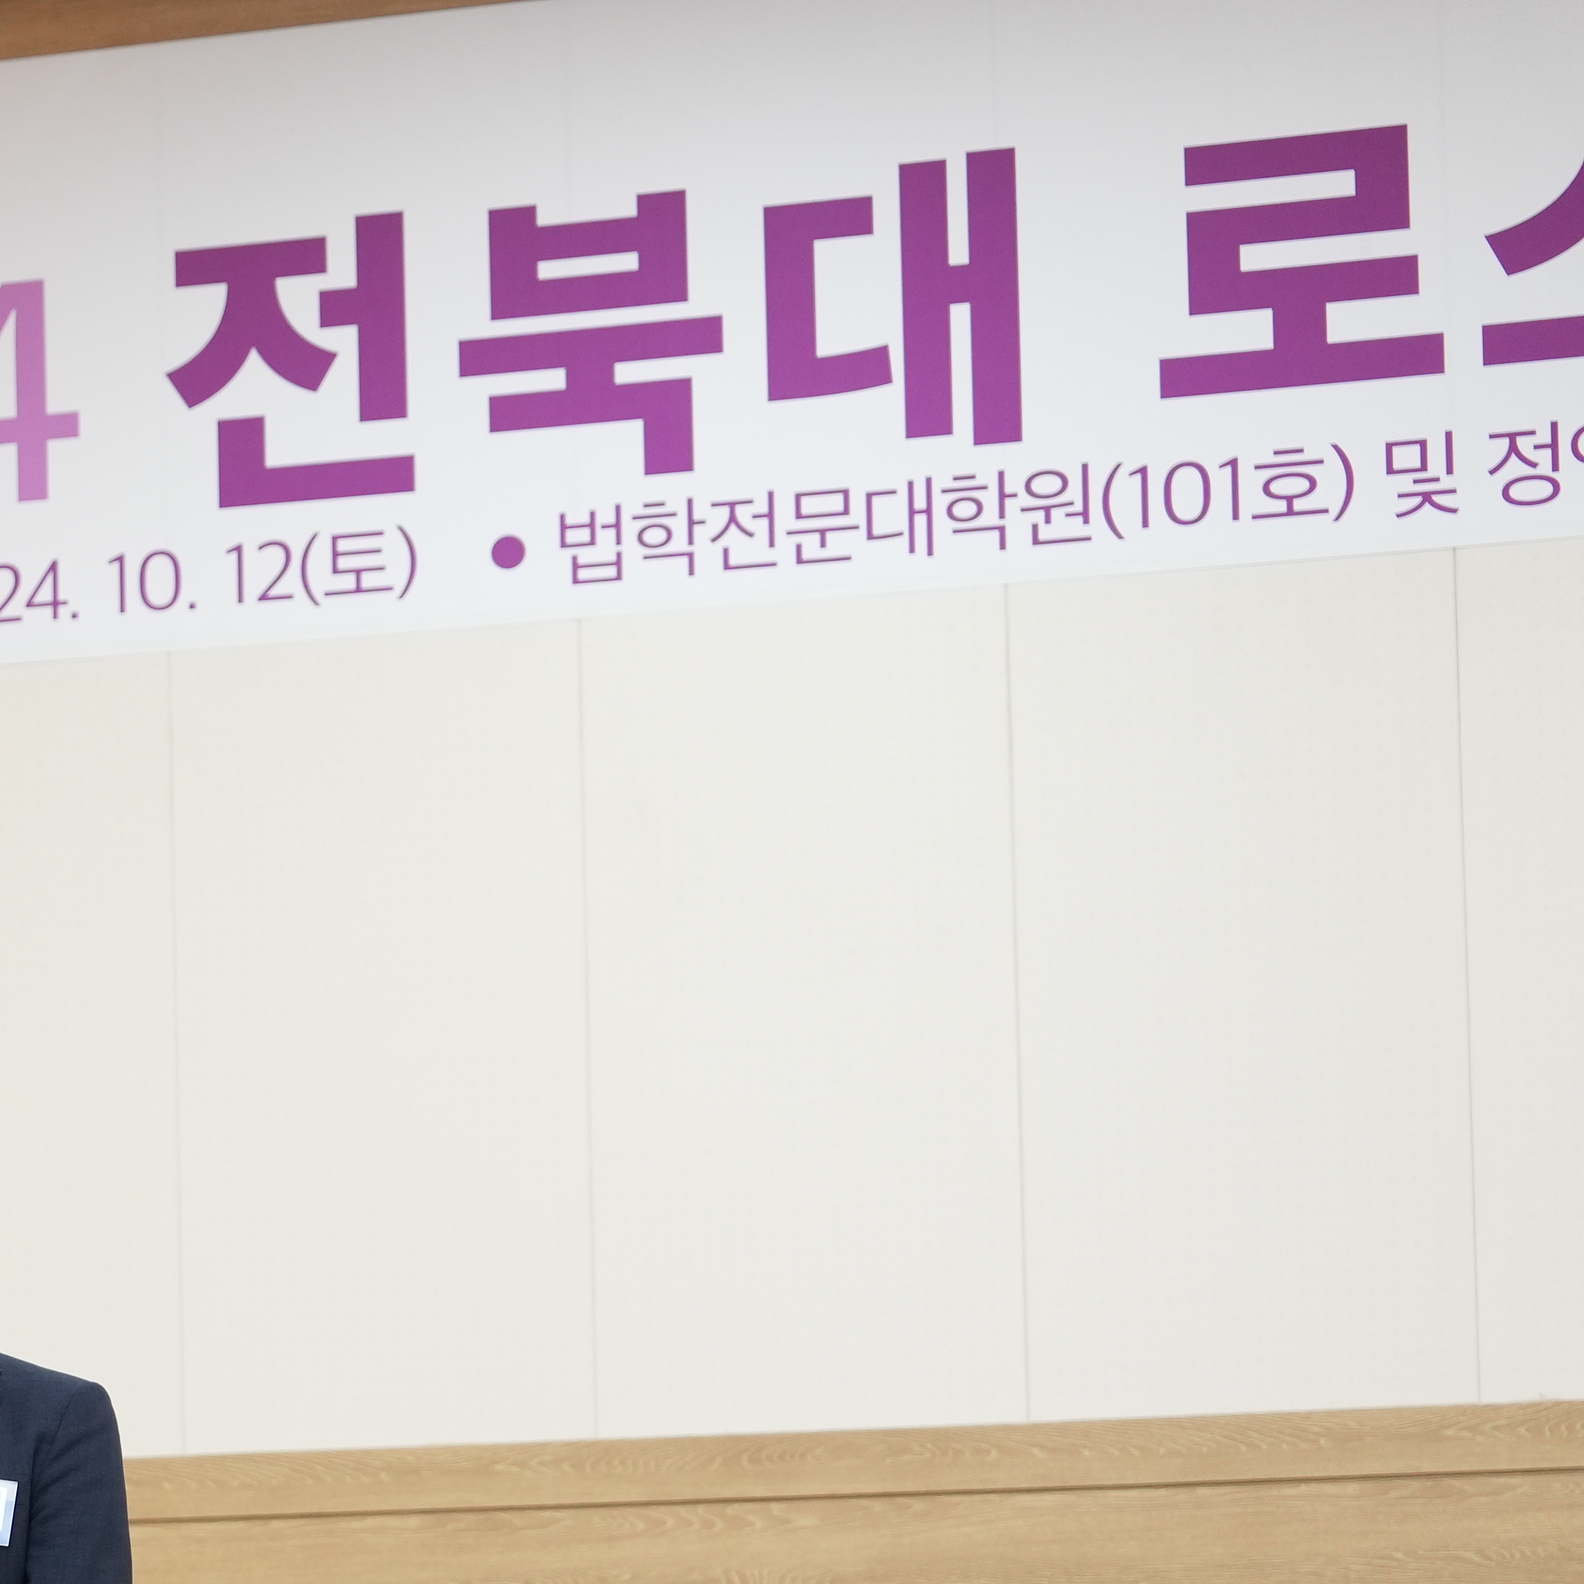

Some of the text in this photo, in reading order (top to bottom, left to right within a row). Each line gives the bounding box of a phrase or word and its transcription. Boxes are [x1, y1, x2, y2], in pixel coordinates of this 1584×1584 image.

[167, 148, 1023, 509] 전북대
[110, 549, 198, 614] 10.
[226, 527, 418, 604] 12(토)
[558, 421, 1584, 586] 법학전문대학원(101호) 및 정
